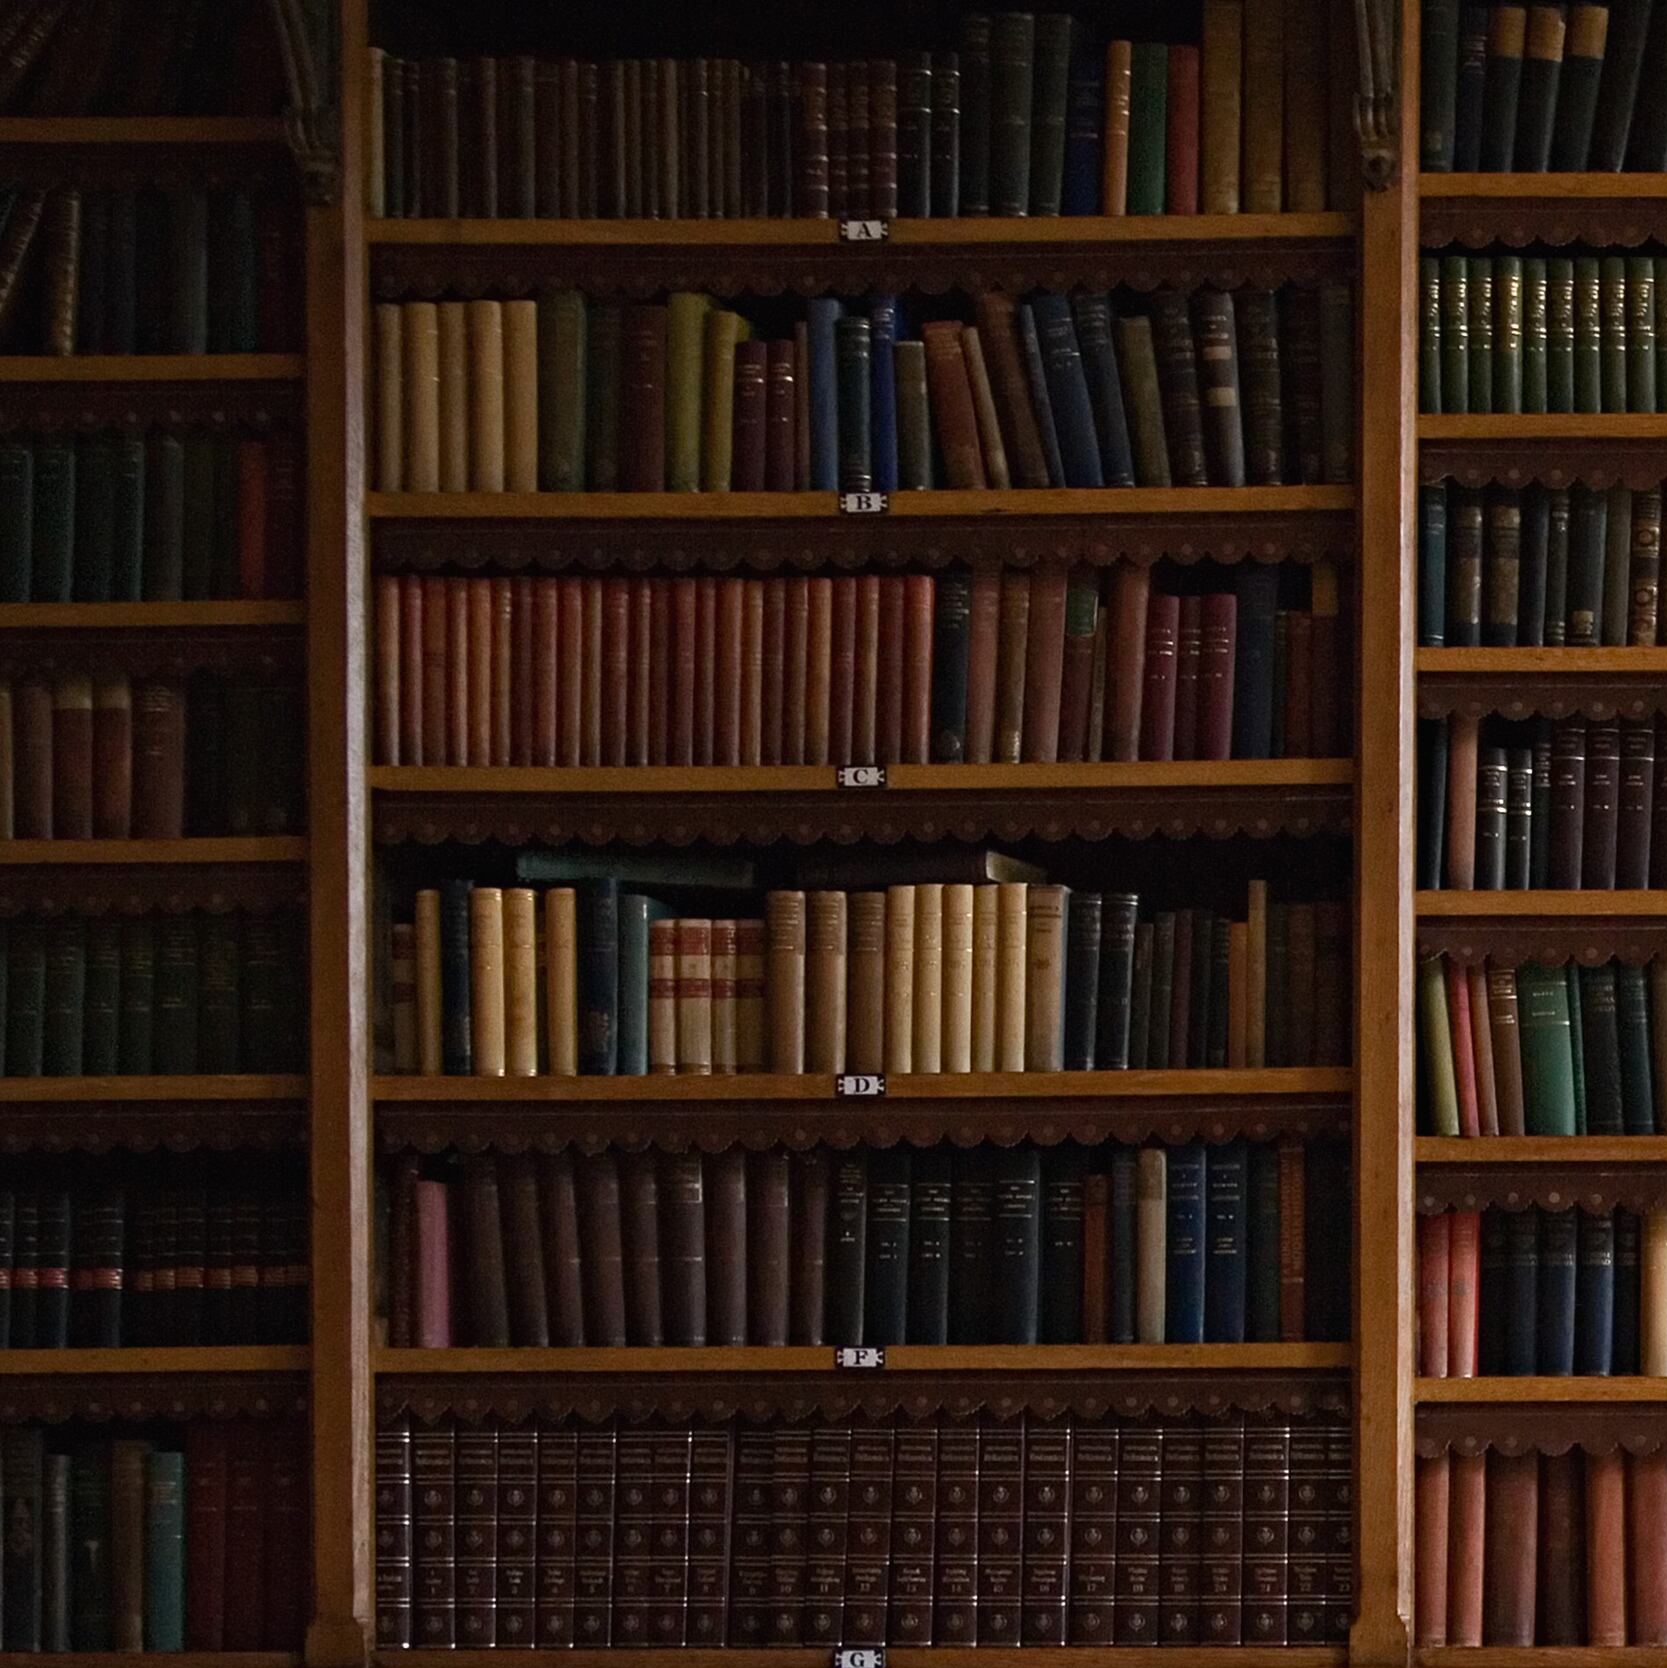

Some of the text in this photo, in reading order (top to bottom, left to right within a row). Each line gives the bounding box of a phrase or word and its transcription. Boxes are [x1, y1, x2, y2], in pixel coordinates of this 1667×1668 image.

[857, 223, 872, 237] A
[856, 496, 872, 510] B
[853, 770, 868, 783] C
[854, 1078, 870, 1092] D
[854, 1350, 868, 1365] F
[850, 1653, 864, 1667] G
